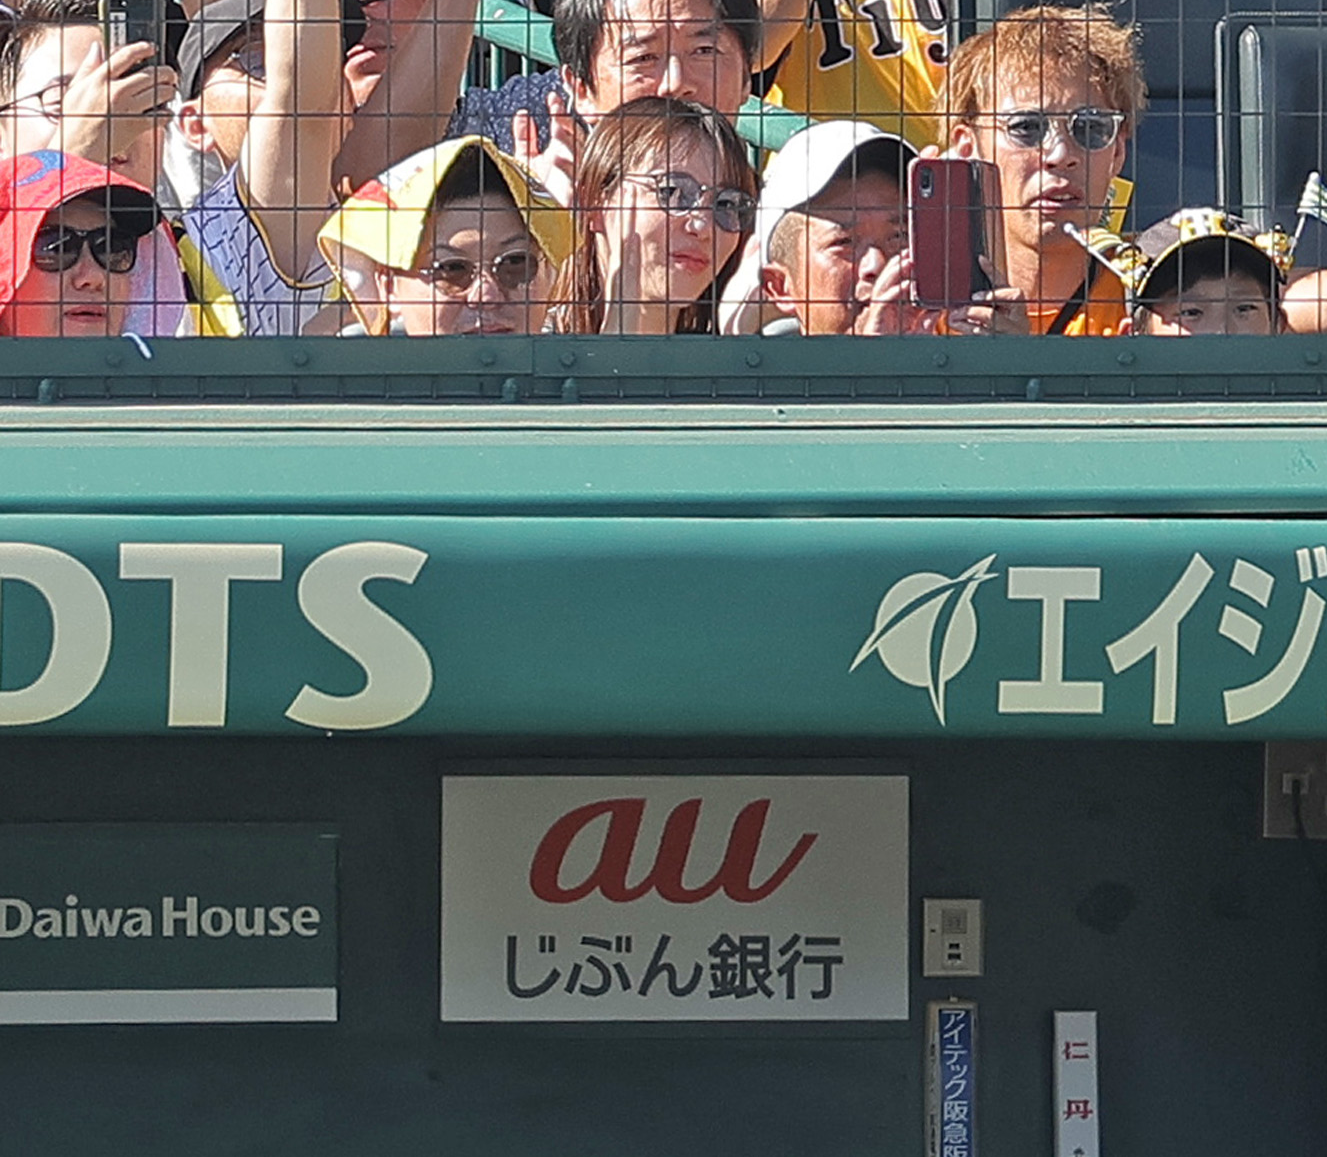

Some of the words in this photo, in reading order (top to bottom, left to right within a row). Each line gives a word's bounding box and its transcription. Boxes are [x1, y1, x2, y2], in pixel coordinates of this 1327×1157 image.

[529, 797, 818, 905] au
[0, 894, 153, 939] Daiwa
[161, 896, 321, 938] House
[506, 933, 844, 1001] じぶん銀行
[1063, 1041, 1093, 1121] 仁丹
